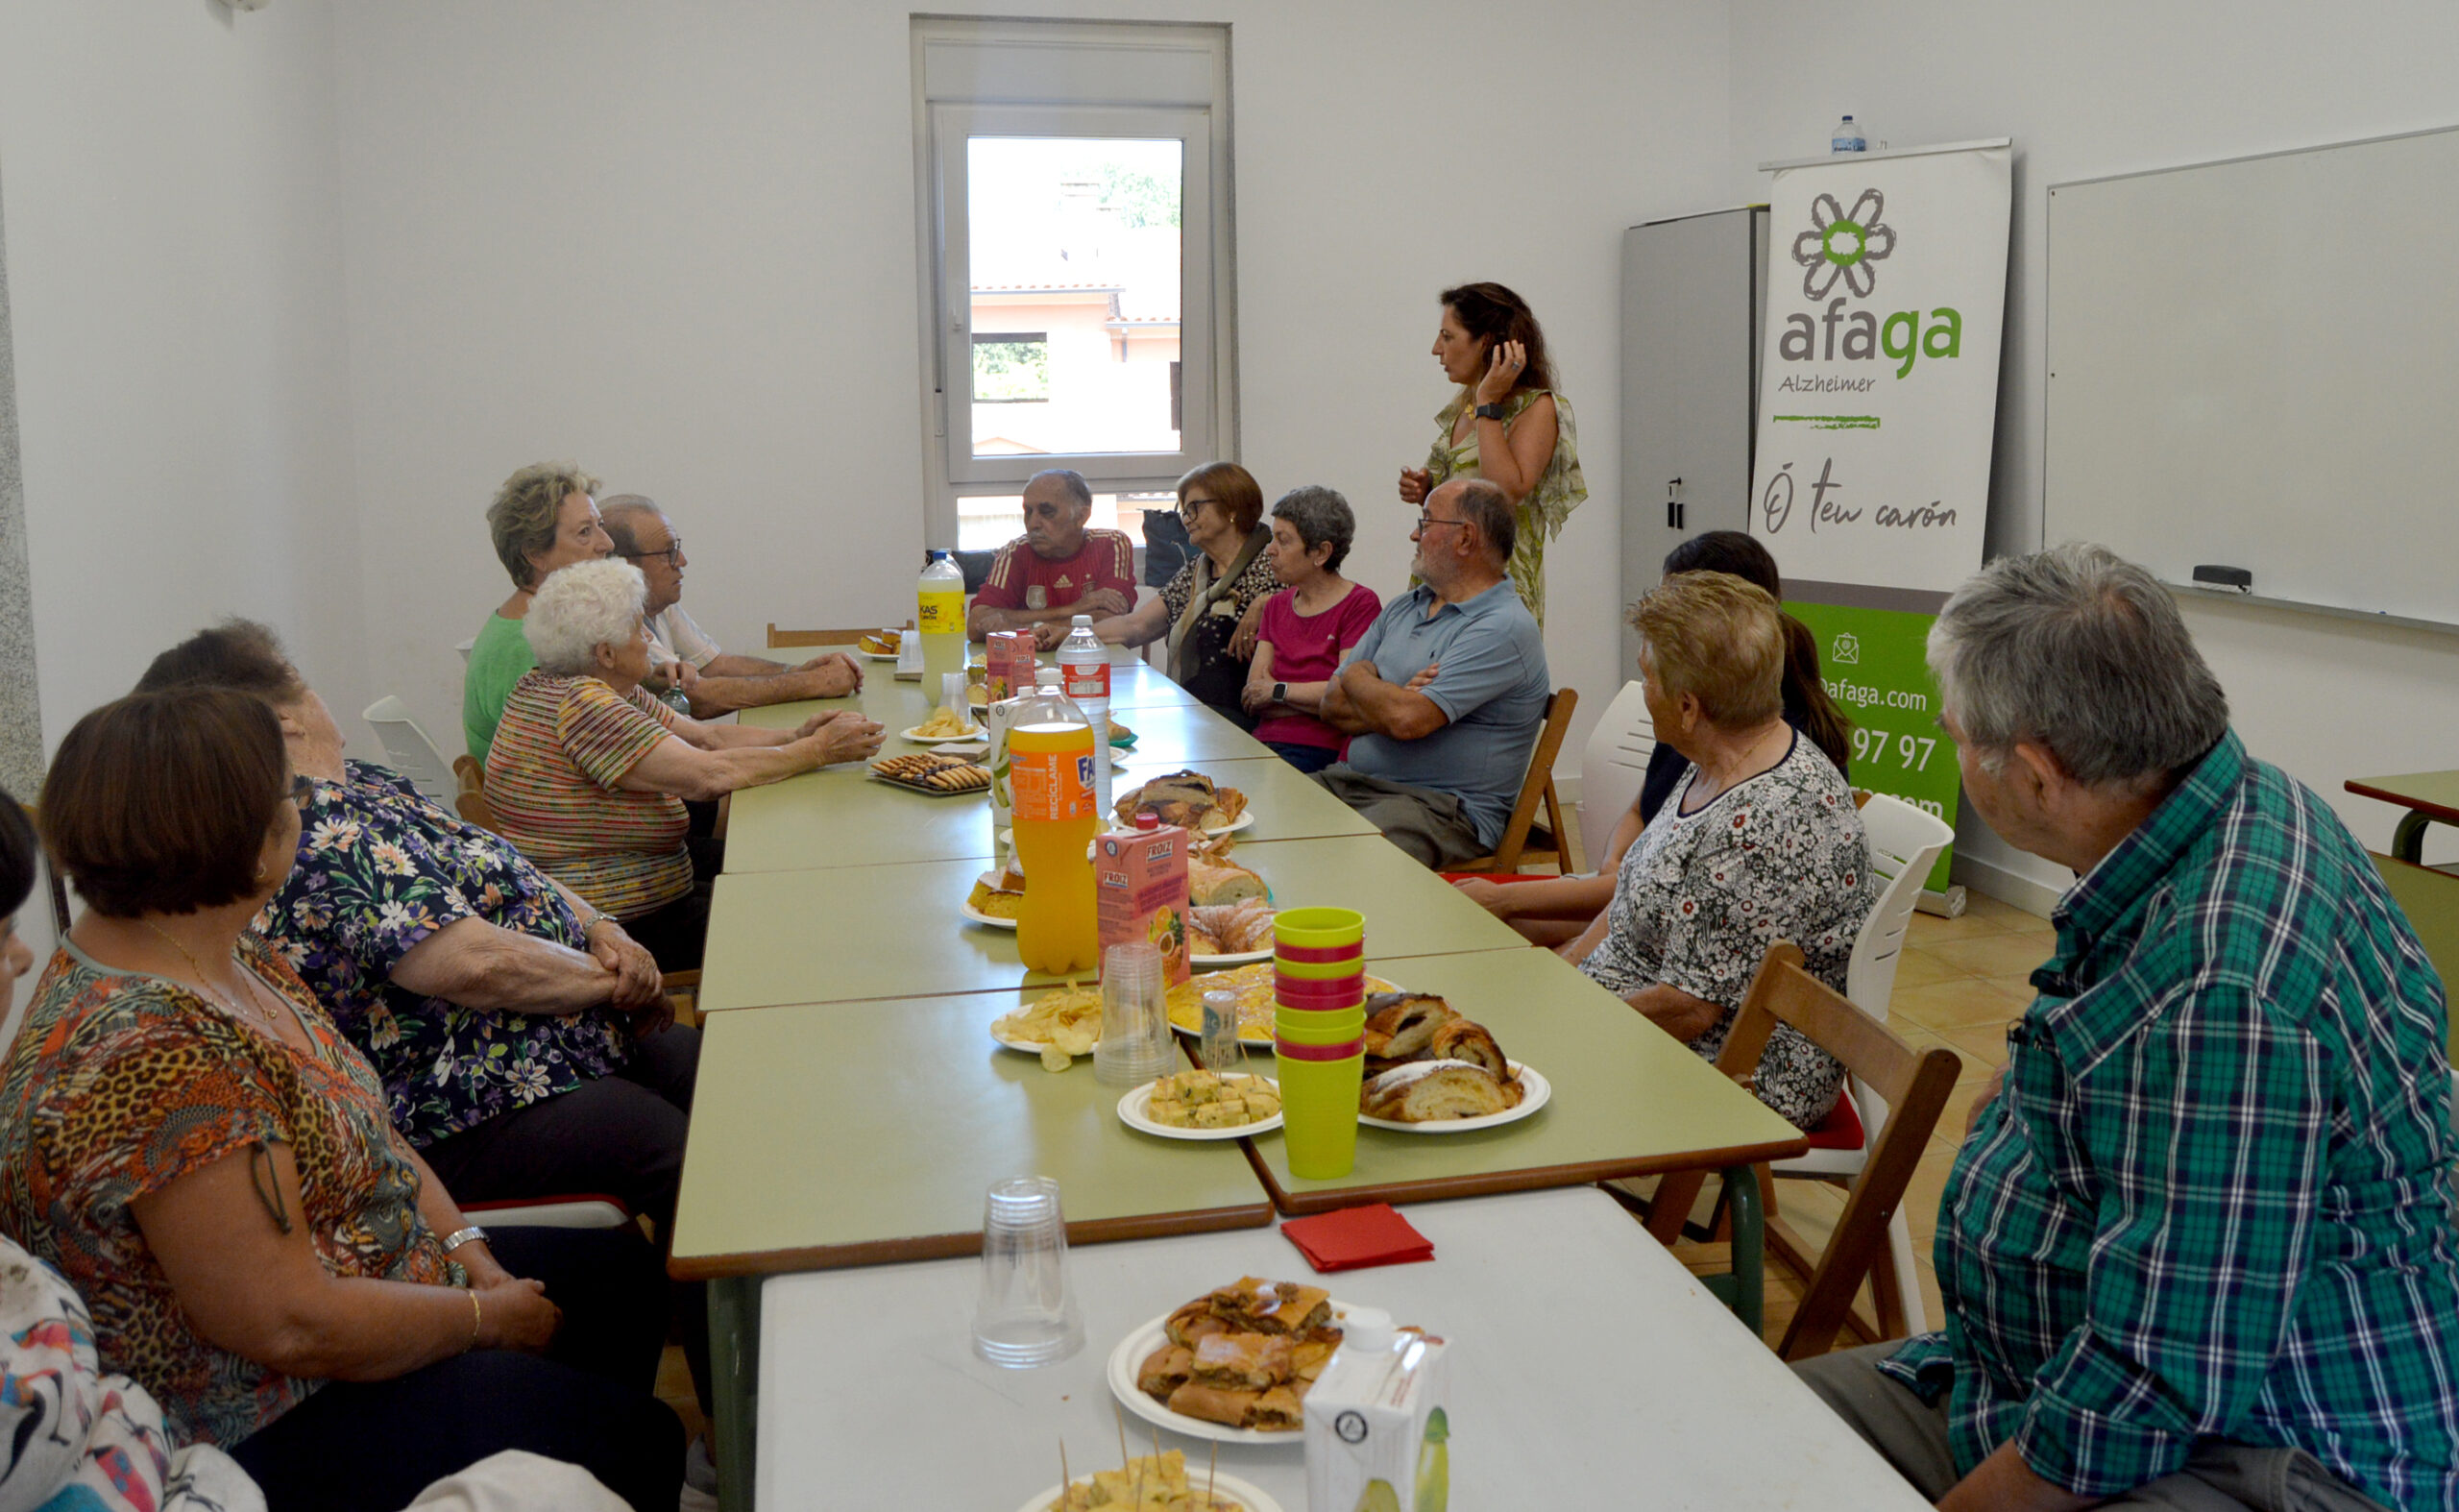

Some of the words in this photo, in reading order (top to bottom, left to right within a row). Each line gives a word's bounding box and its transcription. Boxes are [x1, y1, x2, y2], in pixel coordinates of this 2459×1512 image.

[1779, 297, 1962, 380] afaga
[1778, 374, 1876, 393] Alzheimer
[1764, 462, 1794, 534] Ó
[1875, 500, 1957, 529] carón
[1853, 727, 1889, 764] 97
[1899, 735, 1936, 771] 97
[1147, 841, 1172, 858] FROIZ
[1104, 873, 1128, 885] FROIZ
